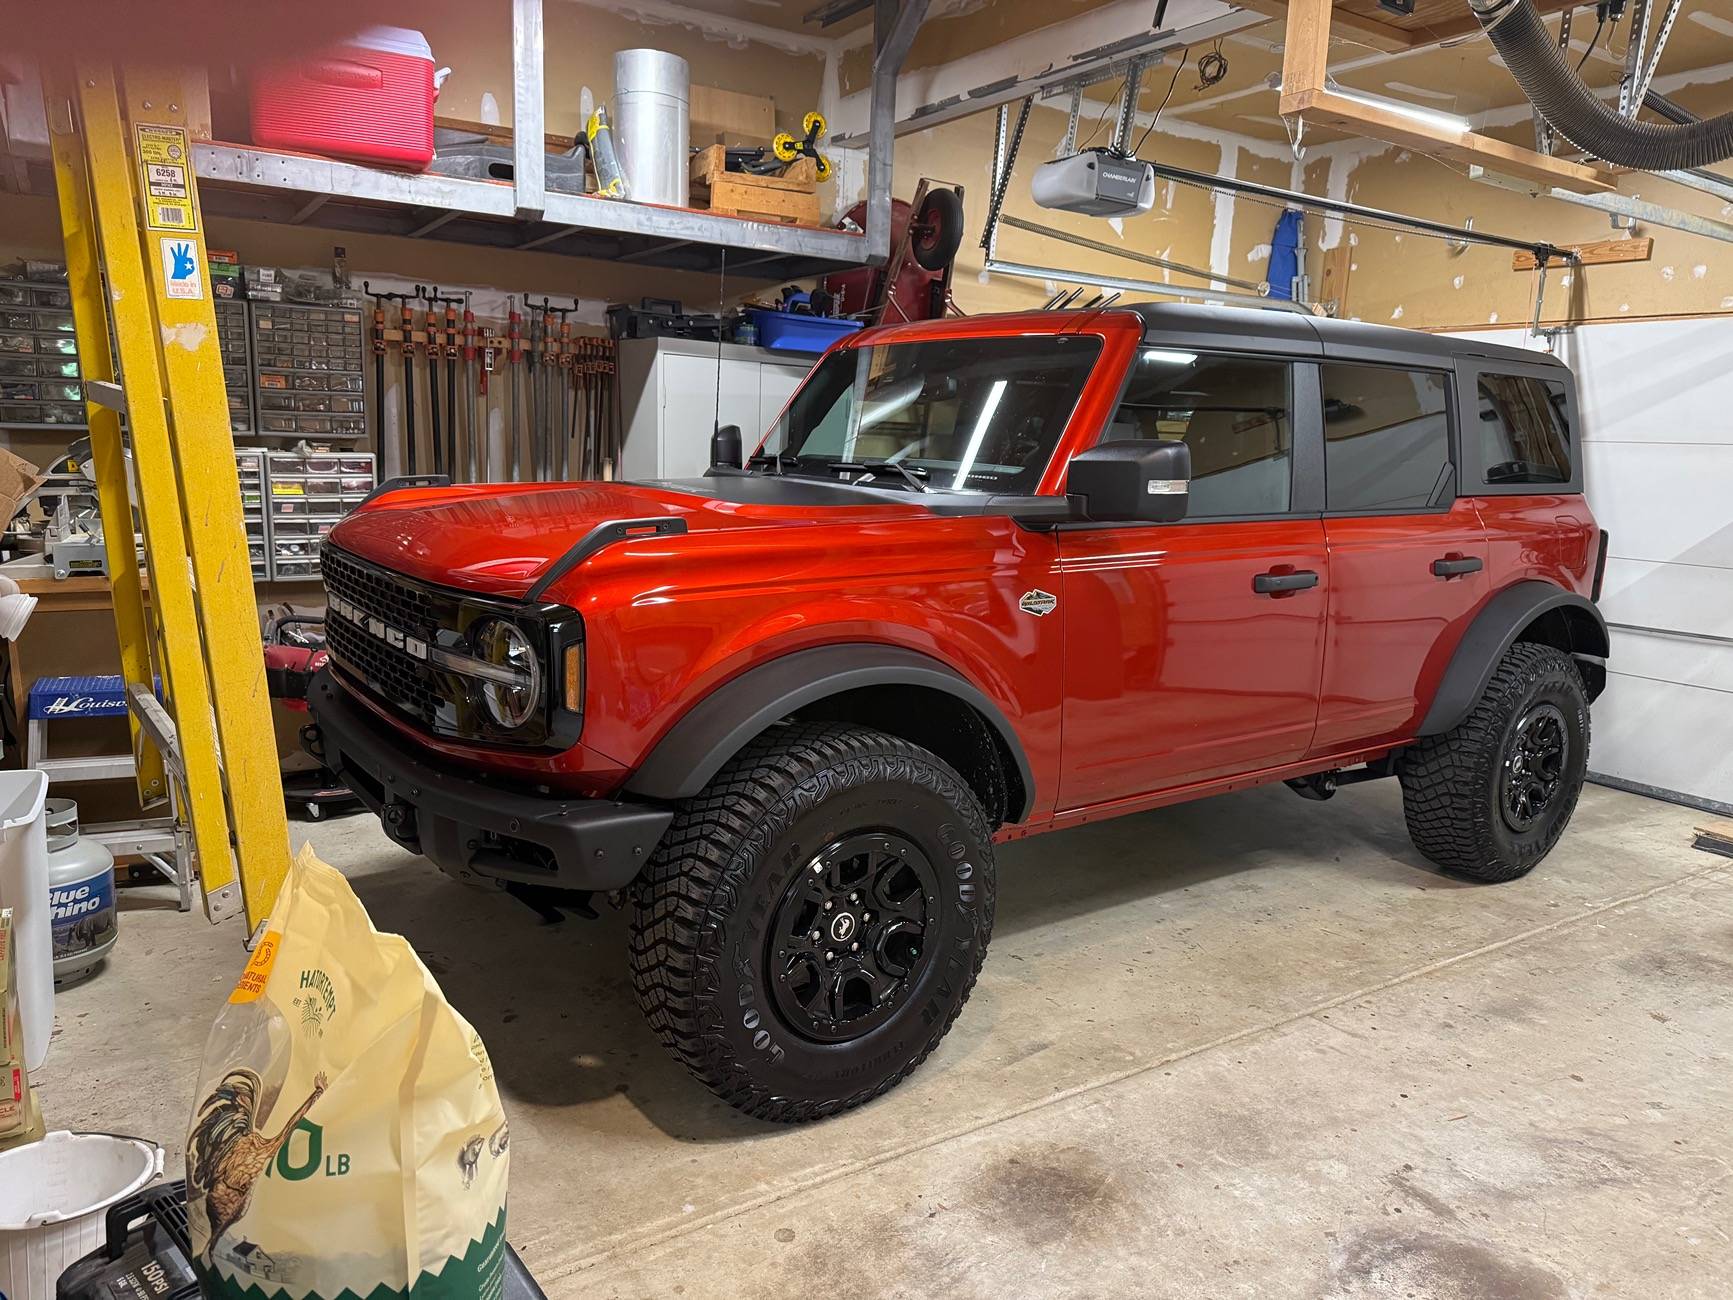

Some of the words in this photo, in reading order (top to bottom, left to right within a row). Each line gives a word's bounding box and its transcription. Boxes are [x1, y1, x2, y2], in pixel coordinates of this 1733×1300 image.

[156, 168, 175, 177] 6258
[1103, 171, 1137, 184] CHAMBERLAIN
[327, 591, 427, 660] BRONCO
[326, 1153, 351, 1176] LB
